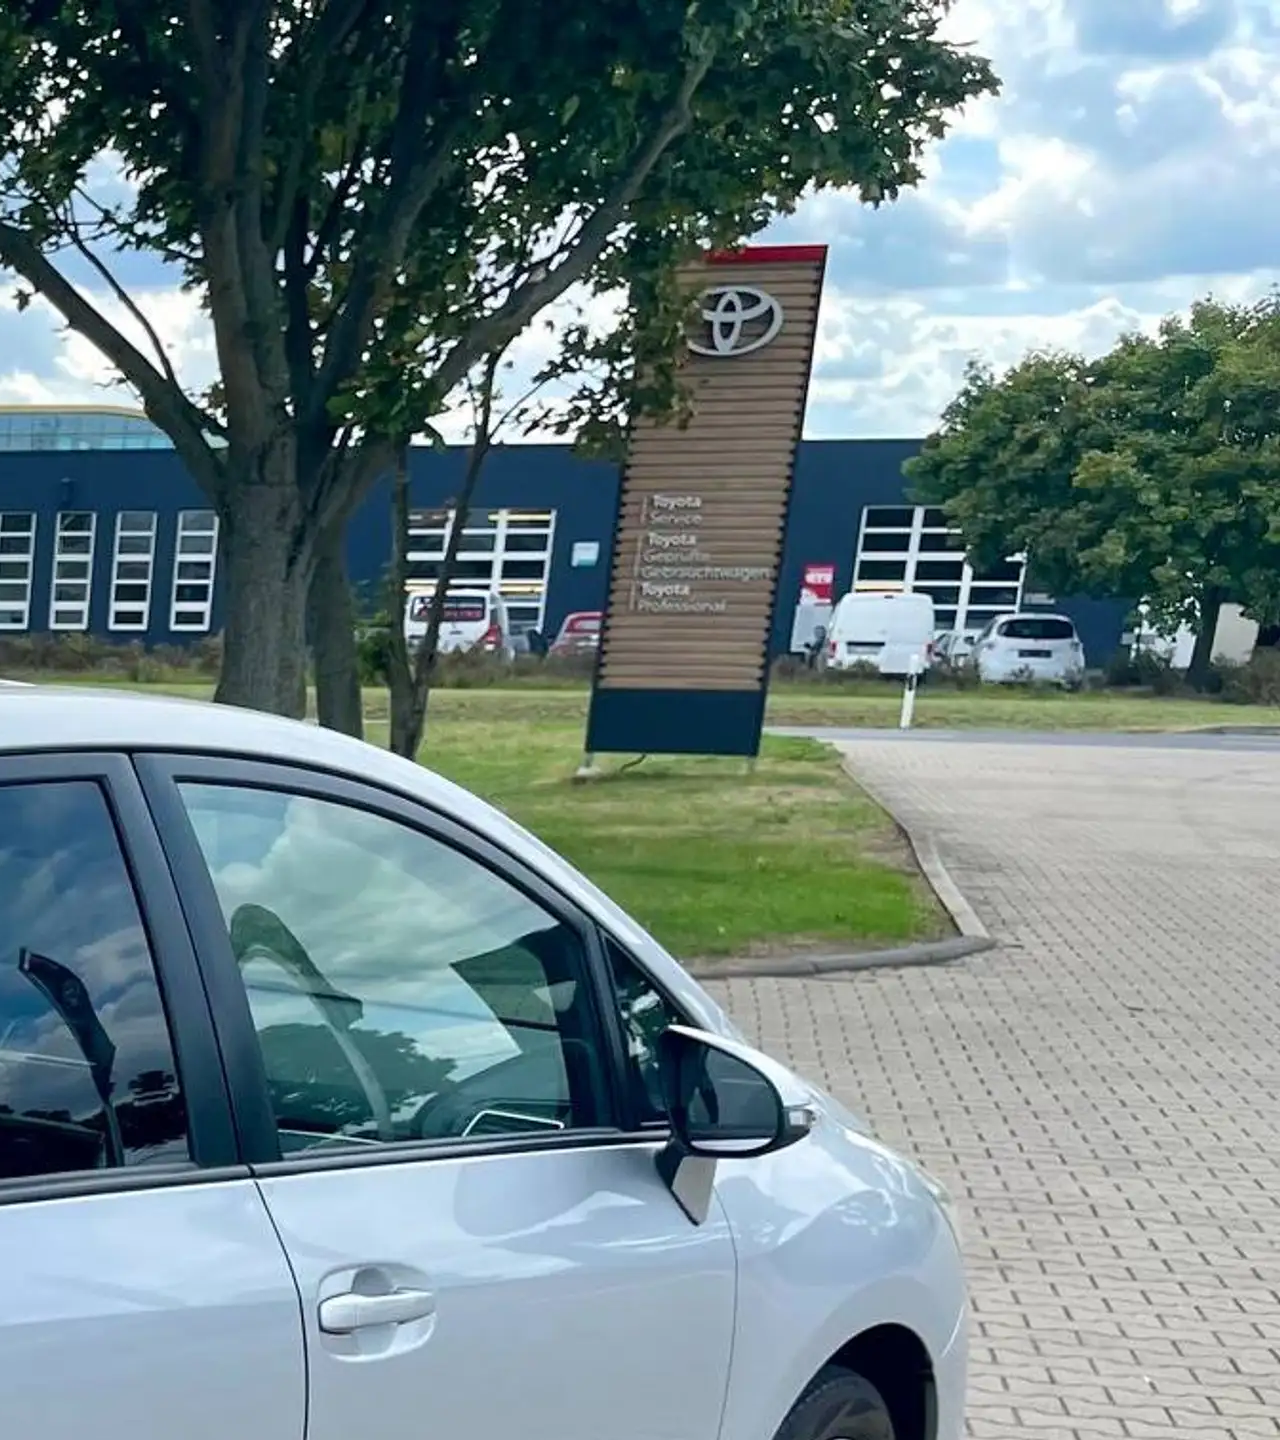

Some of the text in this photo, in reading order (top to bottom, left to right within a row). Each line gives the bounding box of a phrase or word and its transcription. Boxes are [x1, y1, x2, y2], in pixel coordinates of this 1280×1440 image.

[653, 494, 702, 510] Toyota
[650, 511, 702, 525] Service
[648, 532, 697, 549] Toyota
[641, 582, 690, 598] Toyota
[637, 599, 727, 613] Professional
